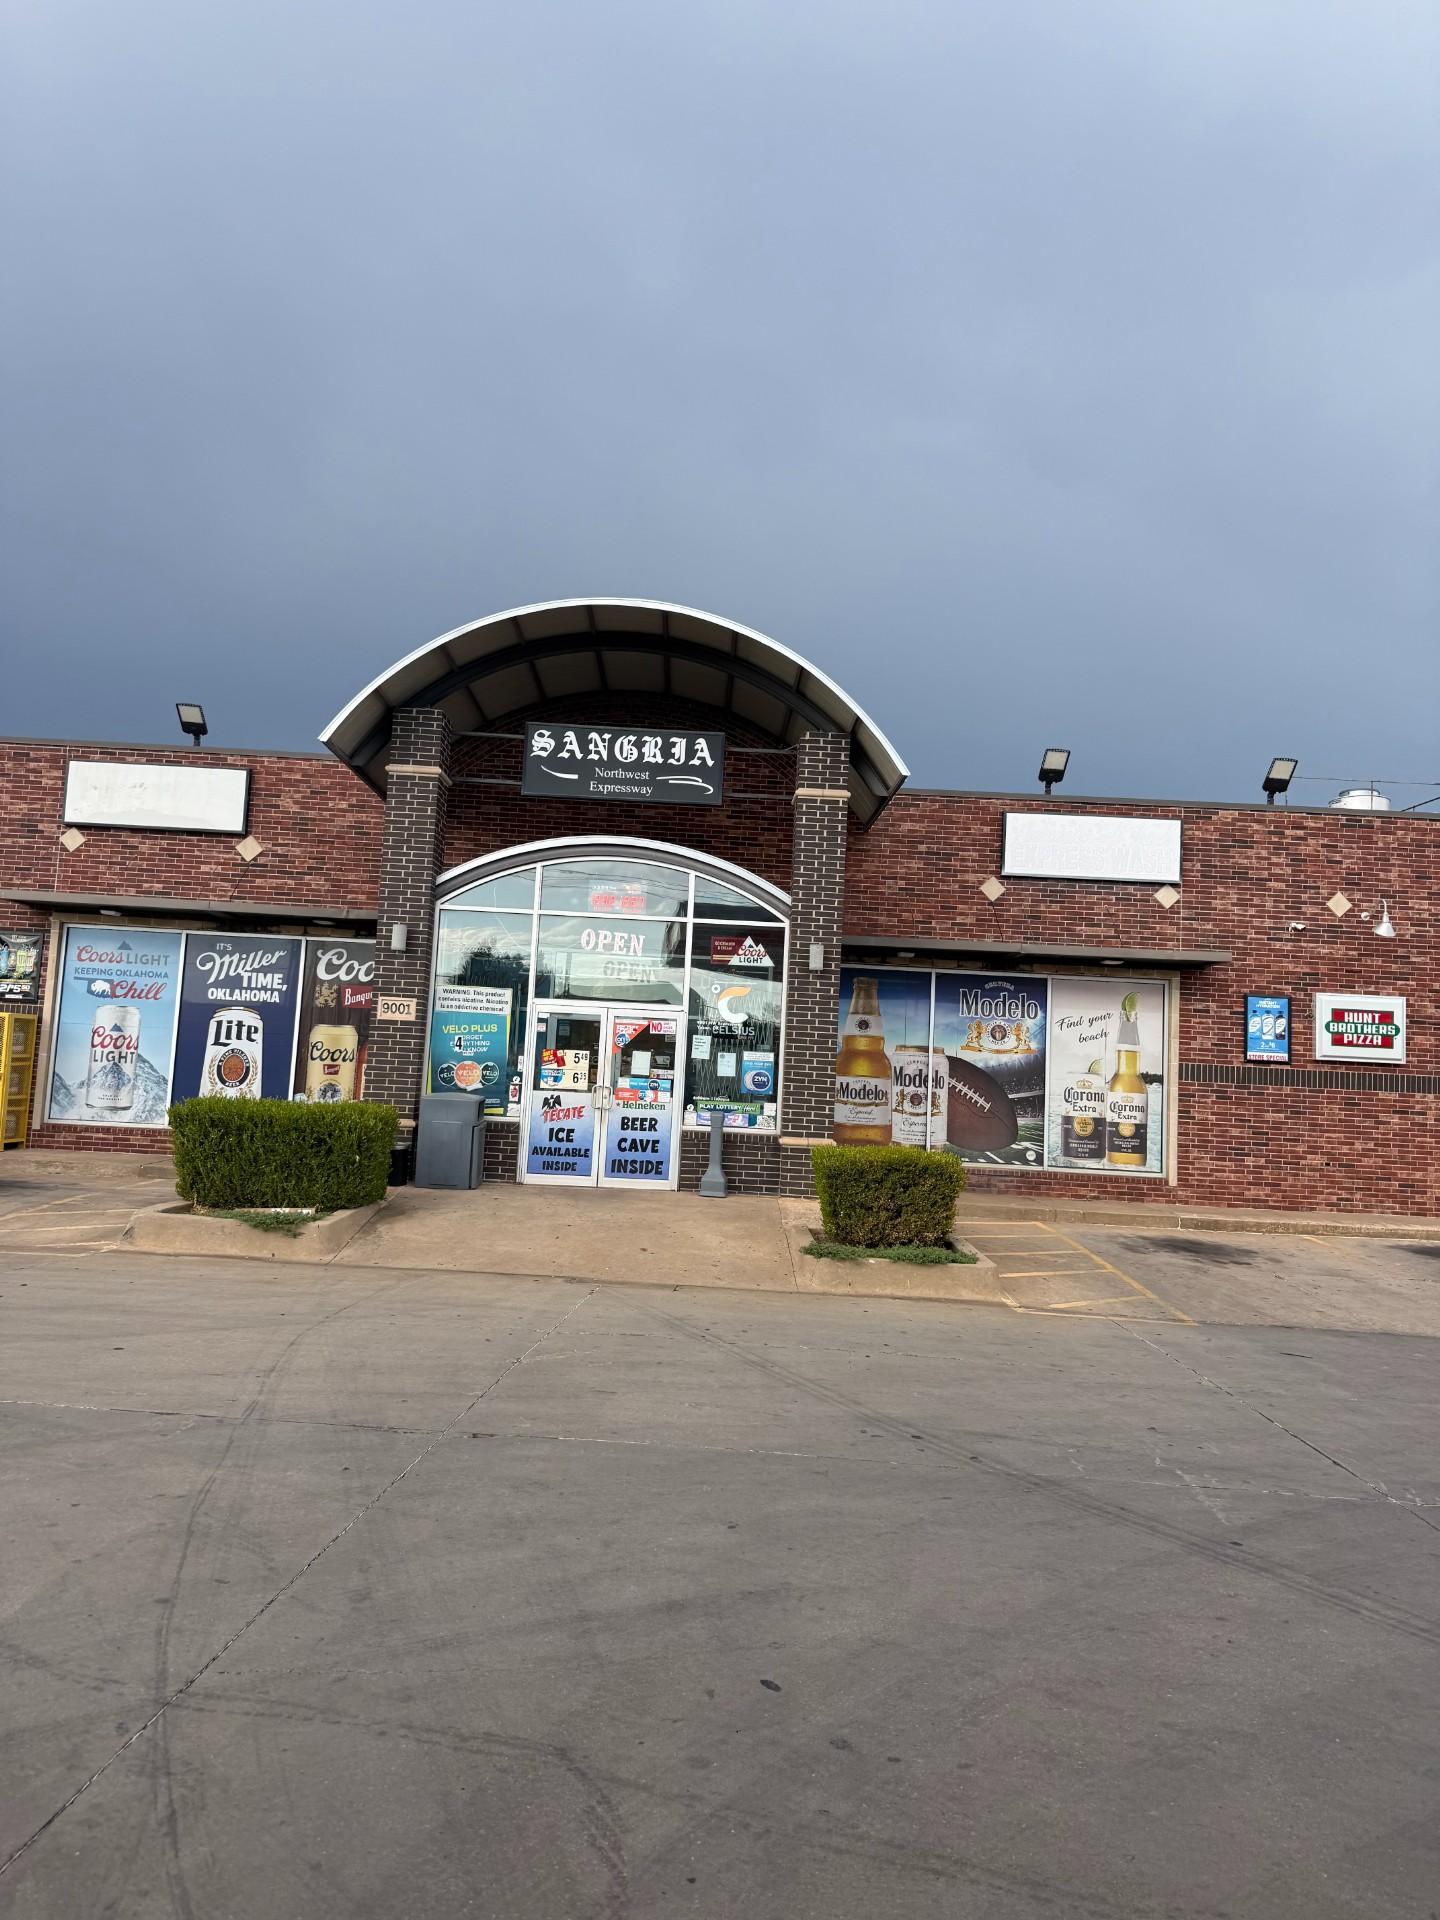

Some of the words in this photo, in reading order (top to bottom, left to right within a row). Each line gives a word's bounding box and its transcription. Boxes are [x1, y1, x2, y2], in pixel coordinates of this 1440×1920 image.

[530, 729, 715, 768] SANGRIA
[595, 767, 650, 780] Northwest
[590, 781, 653, 797] Expressway
[216, 943, 232, 951] IT'S
[581, 928, 646, 957] OPEN
[737, 944, 767, 957] Coors
[77, 944, 124, 963] Coors
[126, 953, 171, 966] LIGHT
[74, 967, 113, 976] KEEPING
[116, 968, 169, 979] OKLAHOMA
[196, 949, 288, 985] Miller
[241, 972, 288, 991] TIME,
[111, 980, 167, 1001] Chill
[208, 987, 280, 1003] OKLAHOMA
[382, 1002, 412, 1015] 9001
[959, 988, 1040, 1020] Modelo
[1055, 1015, 1084, 1032] Find
[1088, 1012, 1114, 1027] your
[1344, 1011, 1381, 1024] HUNT
[210, 1019, 259, 1047] Lite
[442, 1024, 469, 1034] VELO
[471, 1023, 498, 1033] PLUS
[651, 1022, 663, 1032] NO
[712, 1025, 755, 1036] CELSIUS
[1329, 1022, 1396, 1035] BROTHERS
[91, 1025, 139, 1051] Coors
[455, 1036, 463, 1050] 4
[1079, 1028, 1110, 1044] beach
[1343, 1033, 1382, 1046] PIZZA
[93, 1050, 135, 1064] LIGHT
[310, 1040, 356, 1063] Coors
[840, 1081, 884, 1101] Modelo
[622, 1100, 666, 1110] Heineken
[1072, 1103, 1097, 1113] Extra
[1109, 1100, 1145, 1114] Corona
[542, 1105, 586, 1123] TECATE
[1117, 1112, 1138, 1120] Extra
[620, 1116, 658, 1132] BEER
[548, 1127, 575, 1143] ICE
[532, 1146, 590, 1158] AVAILABLE
[617, 1137, 660, 1153] CAVE
[542, 1160, 577, 1171] INSIDE
[611, 1159, 664, 1175] INSIDE
